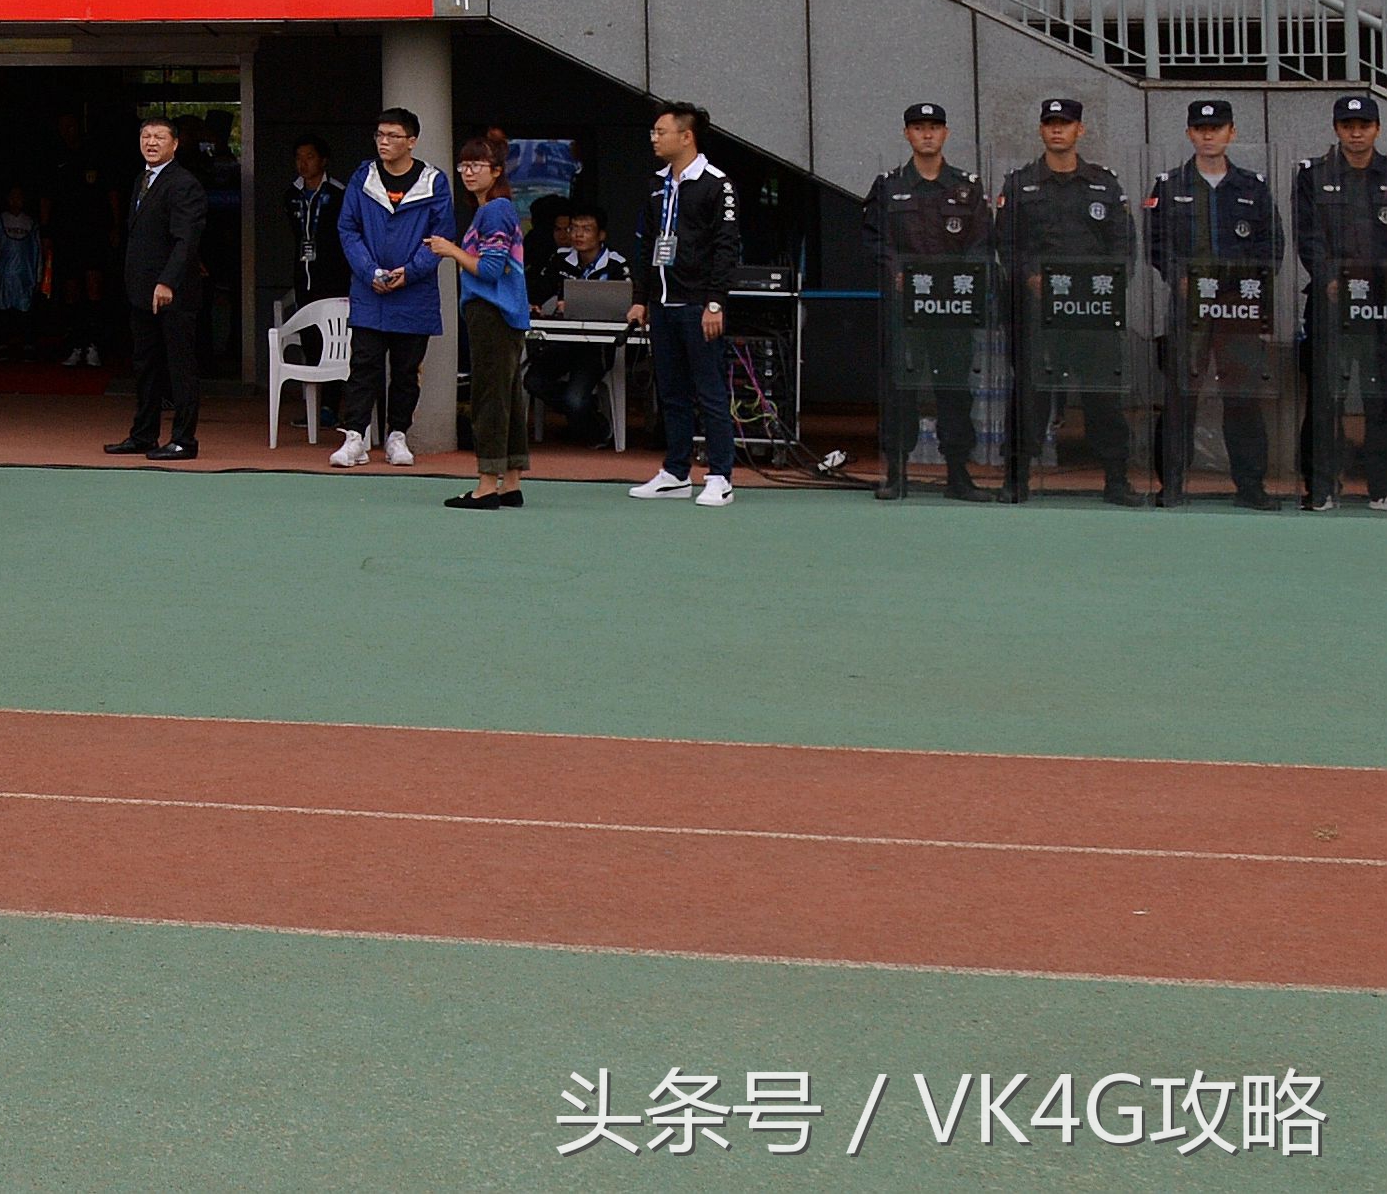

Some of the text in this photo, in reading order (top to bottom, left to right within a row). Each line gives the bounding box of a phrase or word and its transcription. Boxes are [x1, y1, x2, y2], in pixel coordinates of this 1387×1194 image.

[912, 274, 974, 295] 警察
[1049, 274, 1113, 296] 警察
[1197, 278, 1261, 300] 警察
[913, 299, 973, 315] POLICE
[1052, 300, 1113, 316] POLICE
[1198, 303, 1260, 320] POLICE
